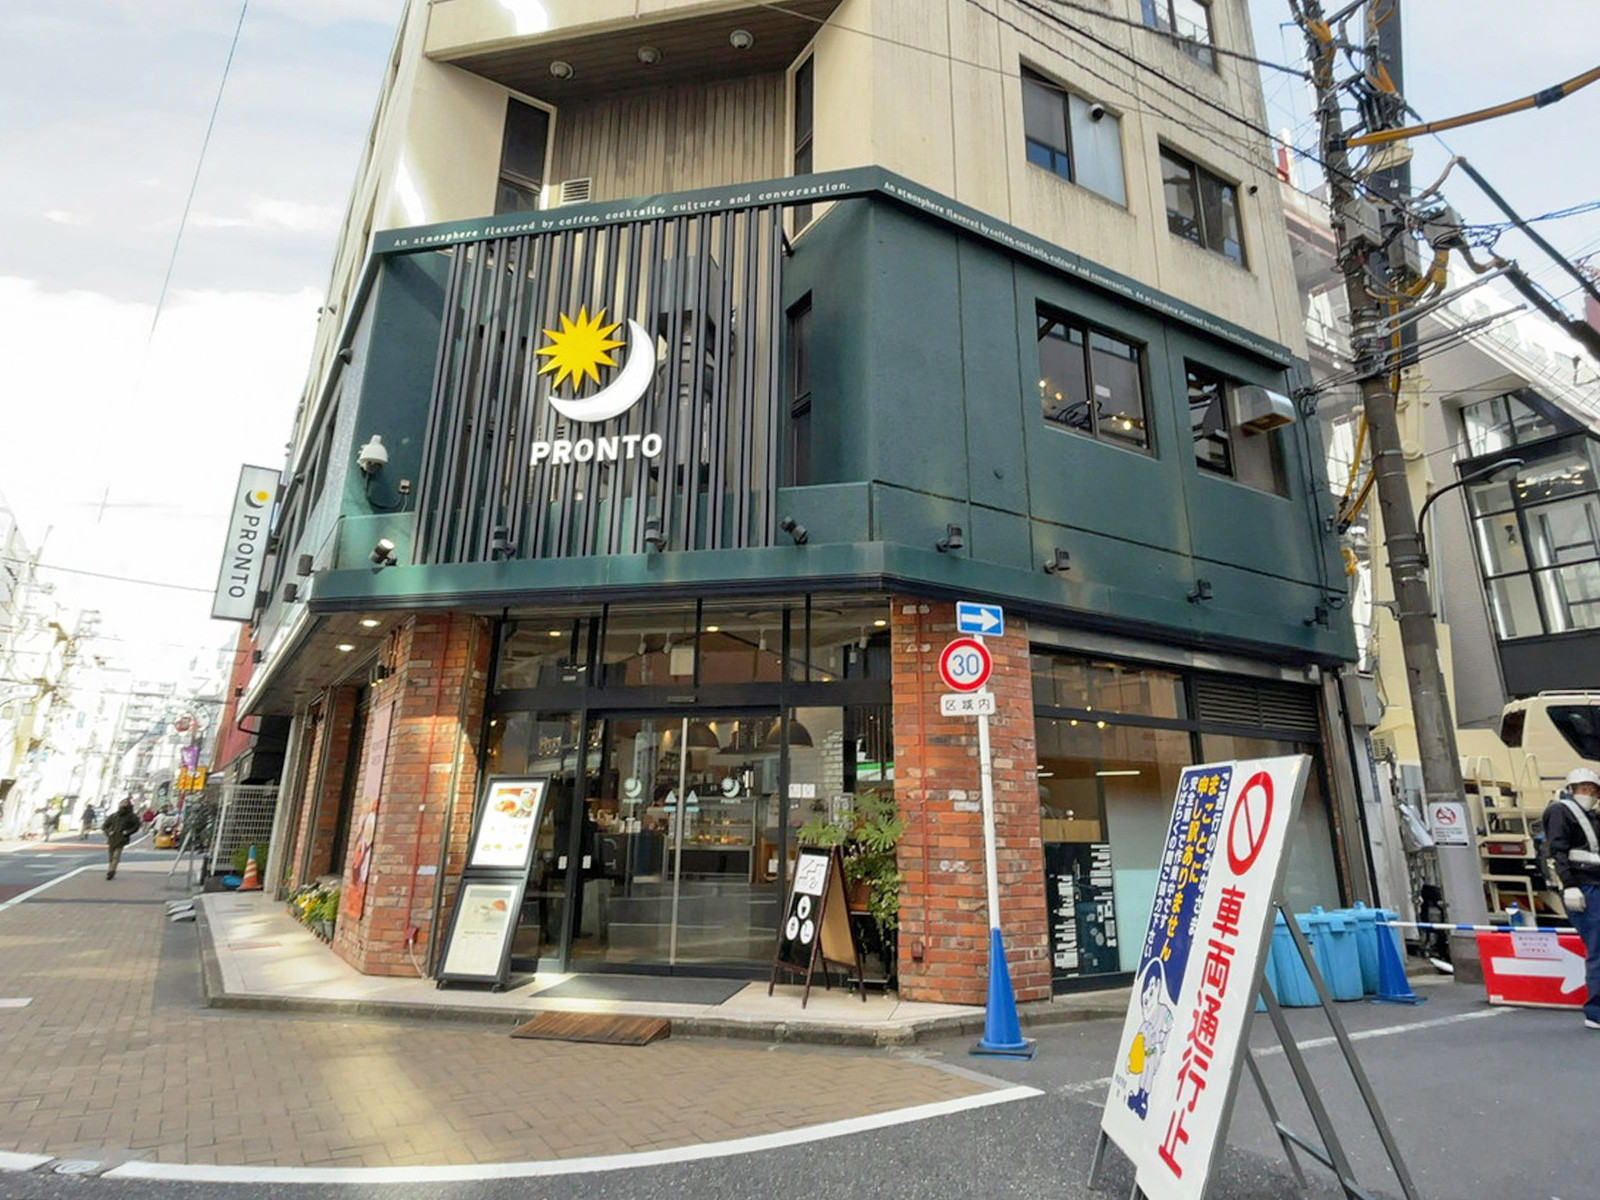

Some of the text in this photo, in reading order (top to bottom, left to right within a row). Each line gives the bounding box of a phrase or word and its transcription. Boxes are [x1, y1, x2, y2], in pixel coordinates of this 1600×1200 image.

[394, 182, 851, 247] An atmosphere flavored by coffee, cocktails, culture and conversation.
[884, 181, 896, 193] An
[897, 187, 945, 215] atmosphere
[946, 208, 980, 229] flavored
[529, 432, 663, 467] PRONTO
[228, 514, 260, 599] PRONTO
[952, 653, 980, 677] 30
[945, 698, 991, 712] 区域内
[1189, 774, 1221, 883] まことに
[1160, 775, 1211, 962] 申し訳ありません
[1158, 883, 1246, 1180] 車両通行止
